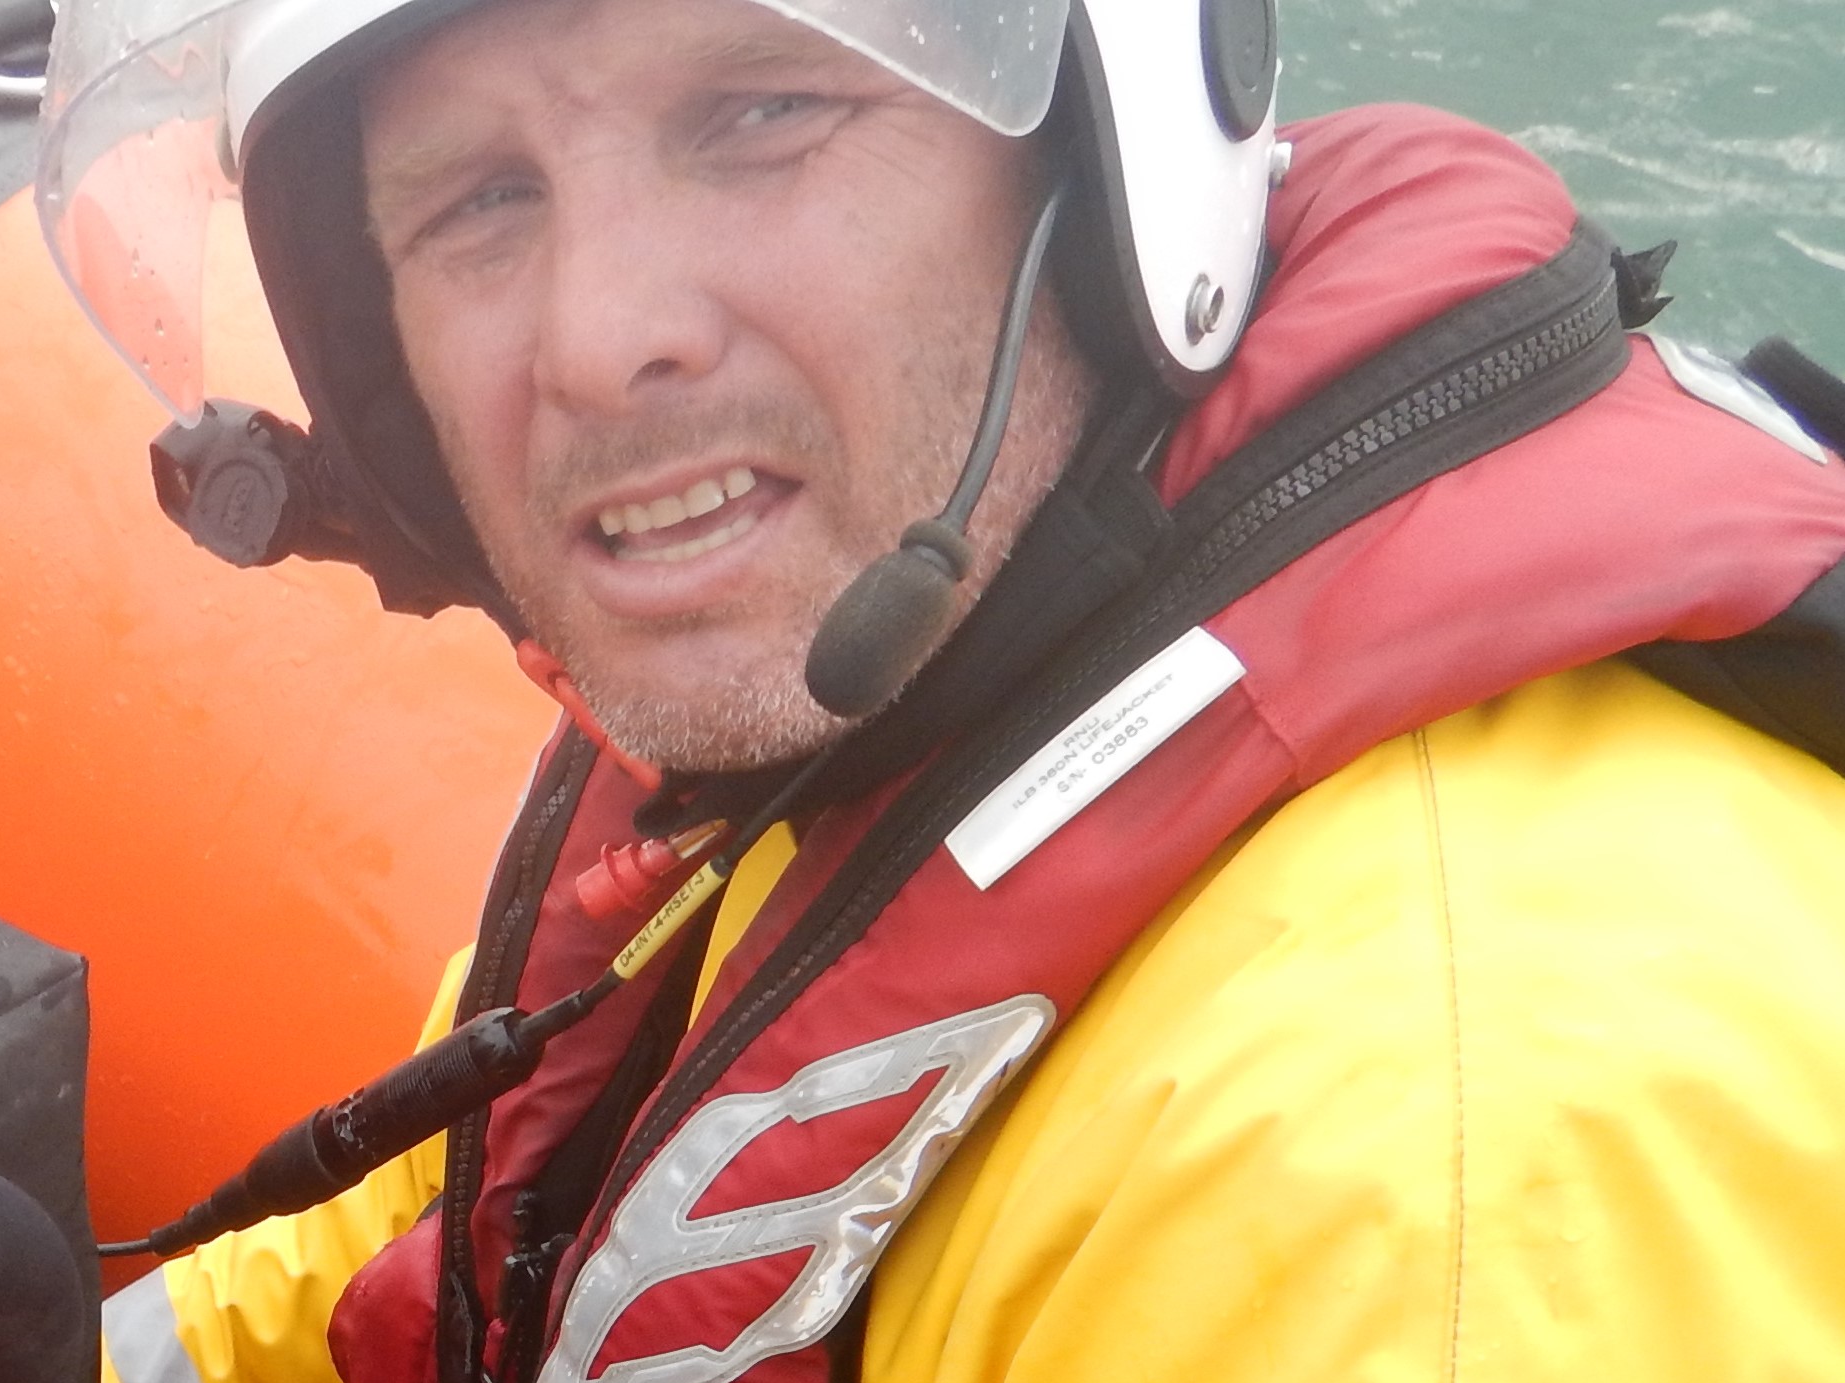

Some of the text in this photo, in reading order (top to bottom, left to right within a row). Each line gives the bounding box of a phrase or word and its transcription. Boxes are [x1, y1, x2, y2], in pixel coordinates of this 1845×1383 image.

[1012, 786, 1037, 809] ILB
[1079, 673, 1173, 750] LIFEJACKET
[1091, 716, 1148, 764] 03883
